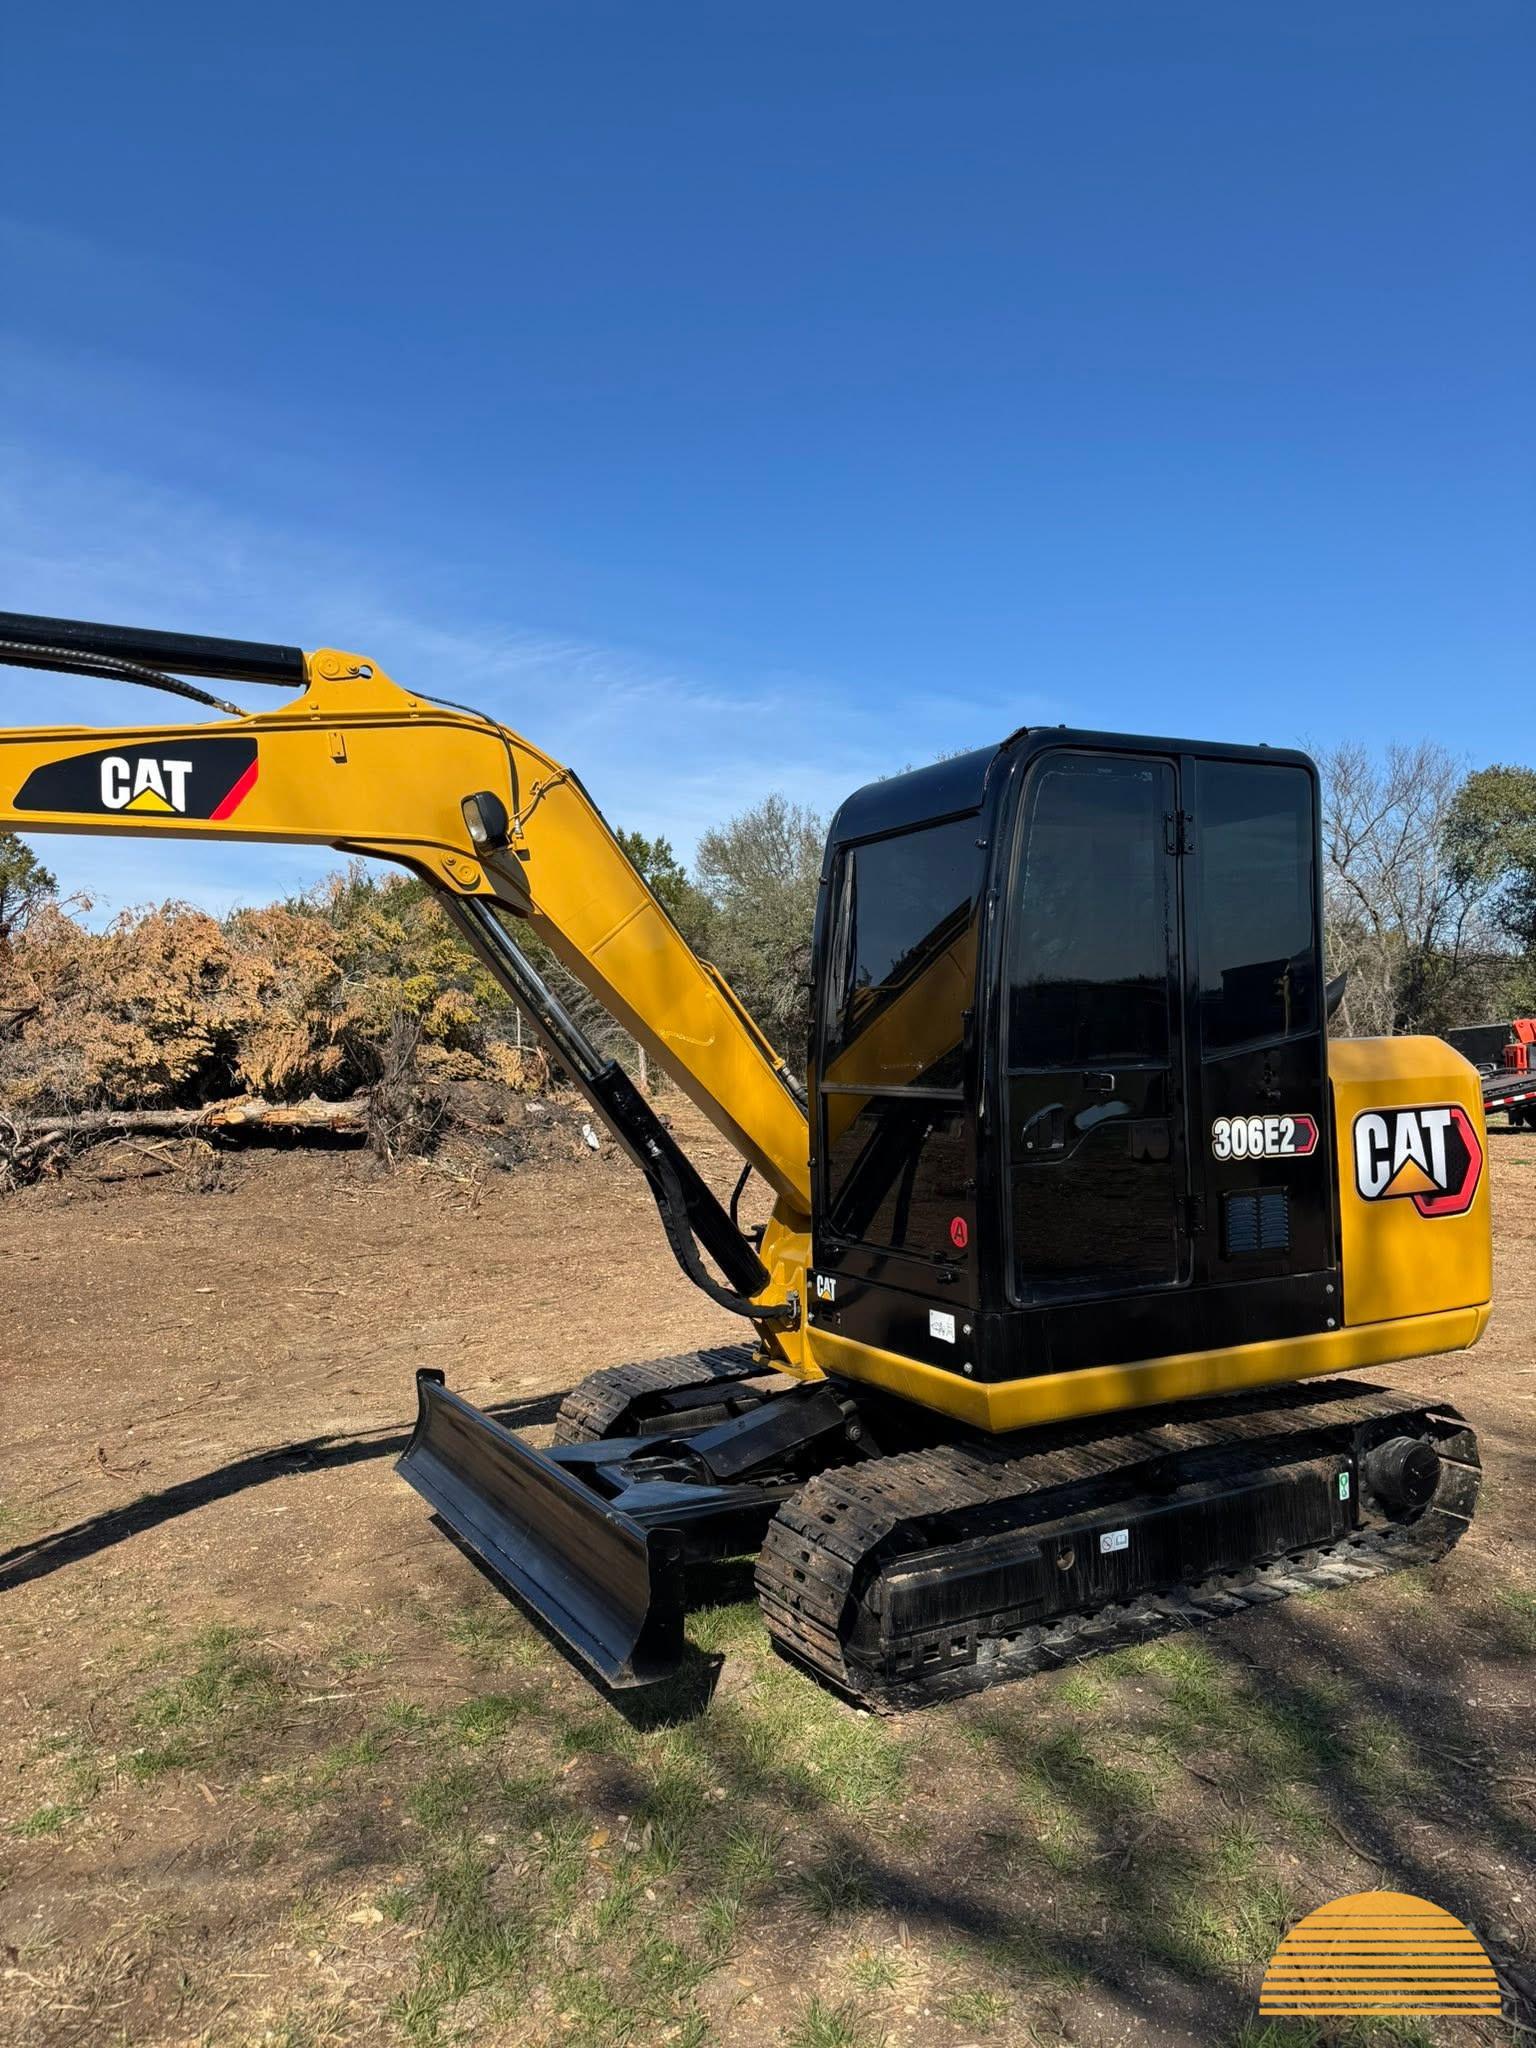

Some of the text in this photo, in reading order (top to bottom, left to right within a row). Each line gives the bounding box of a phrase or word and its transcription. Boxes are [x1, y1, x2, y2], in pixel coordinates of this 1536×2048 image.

[101, 756, 192, 812] CAT
[1214, 1117, 1295, 1157] 306E2
[1355, 1109, 1451, 1197] CAT
[817, 1275, 836, 1301] CAT
